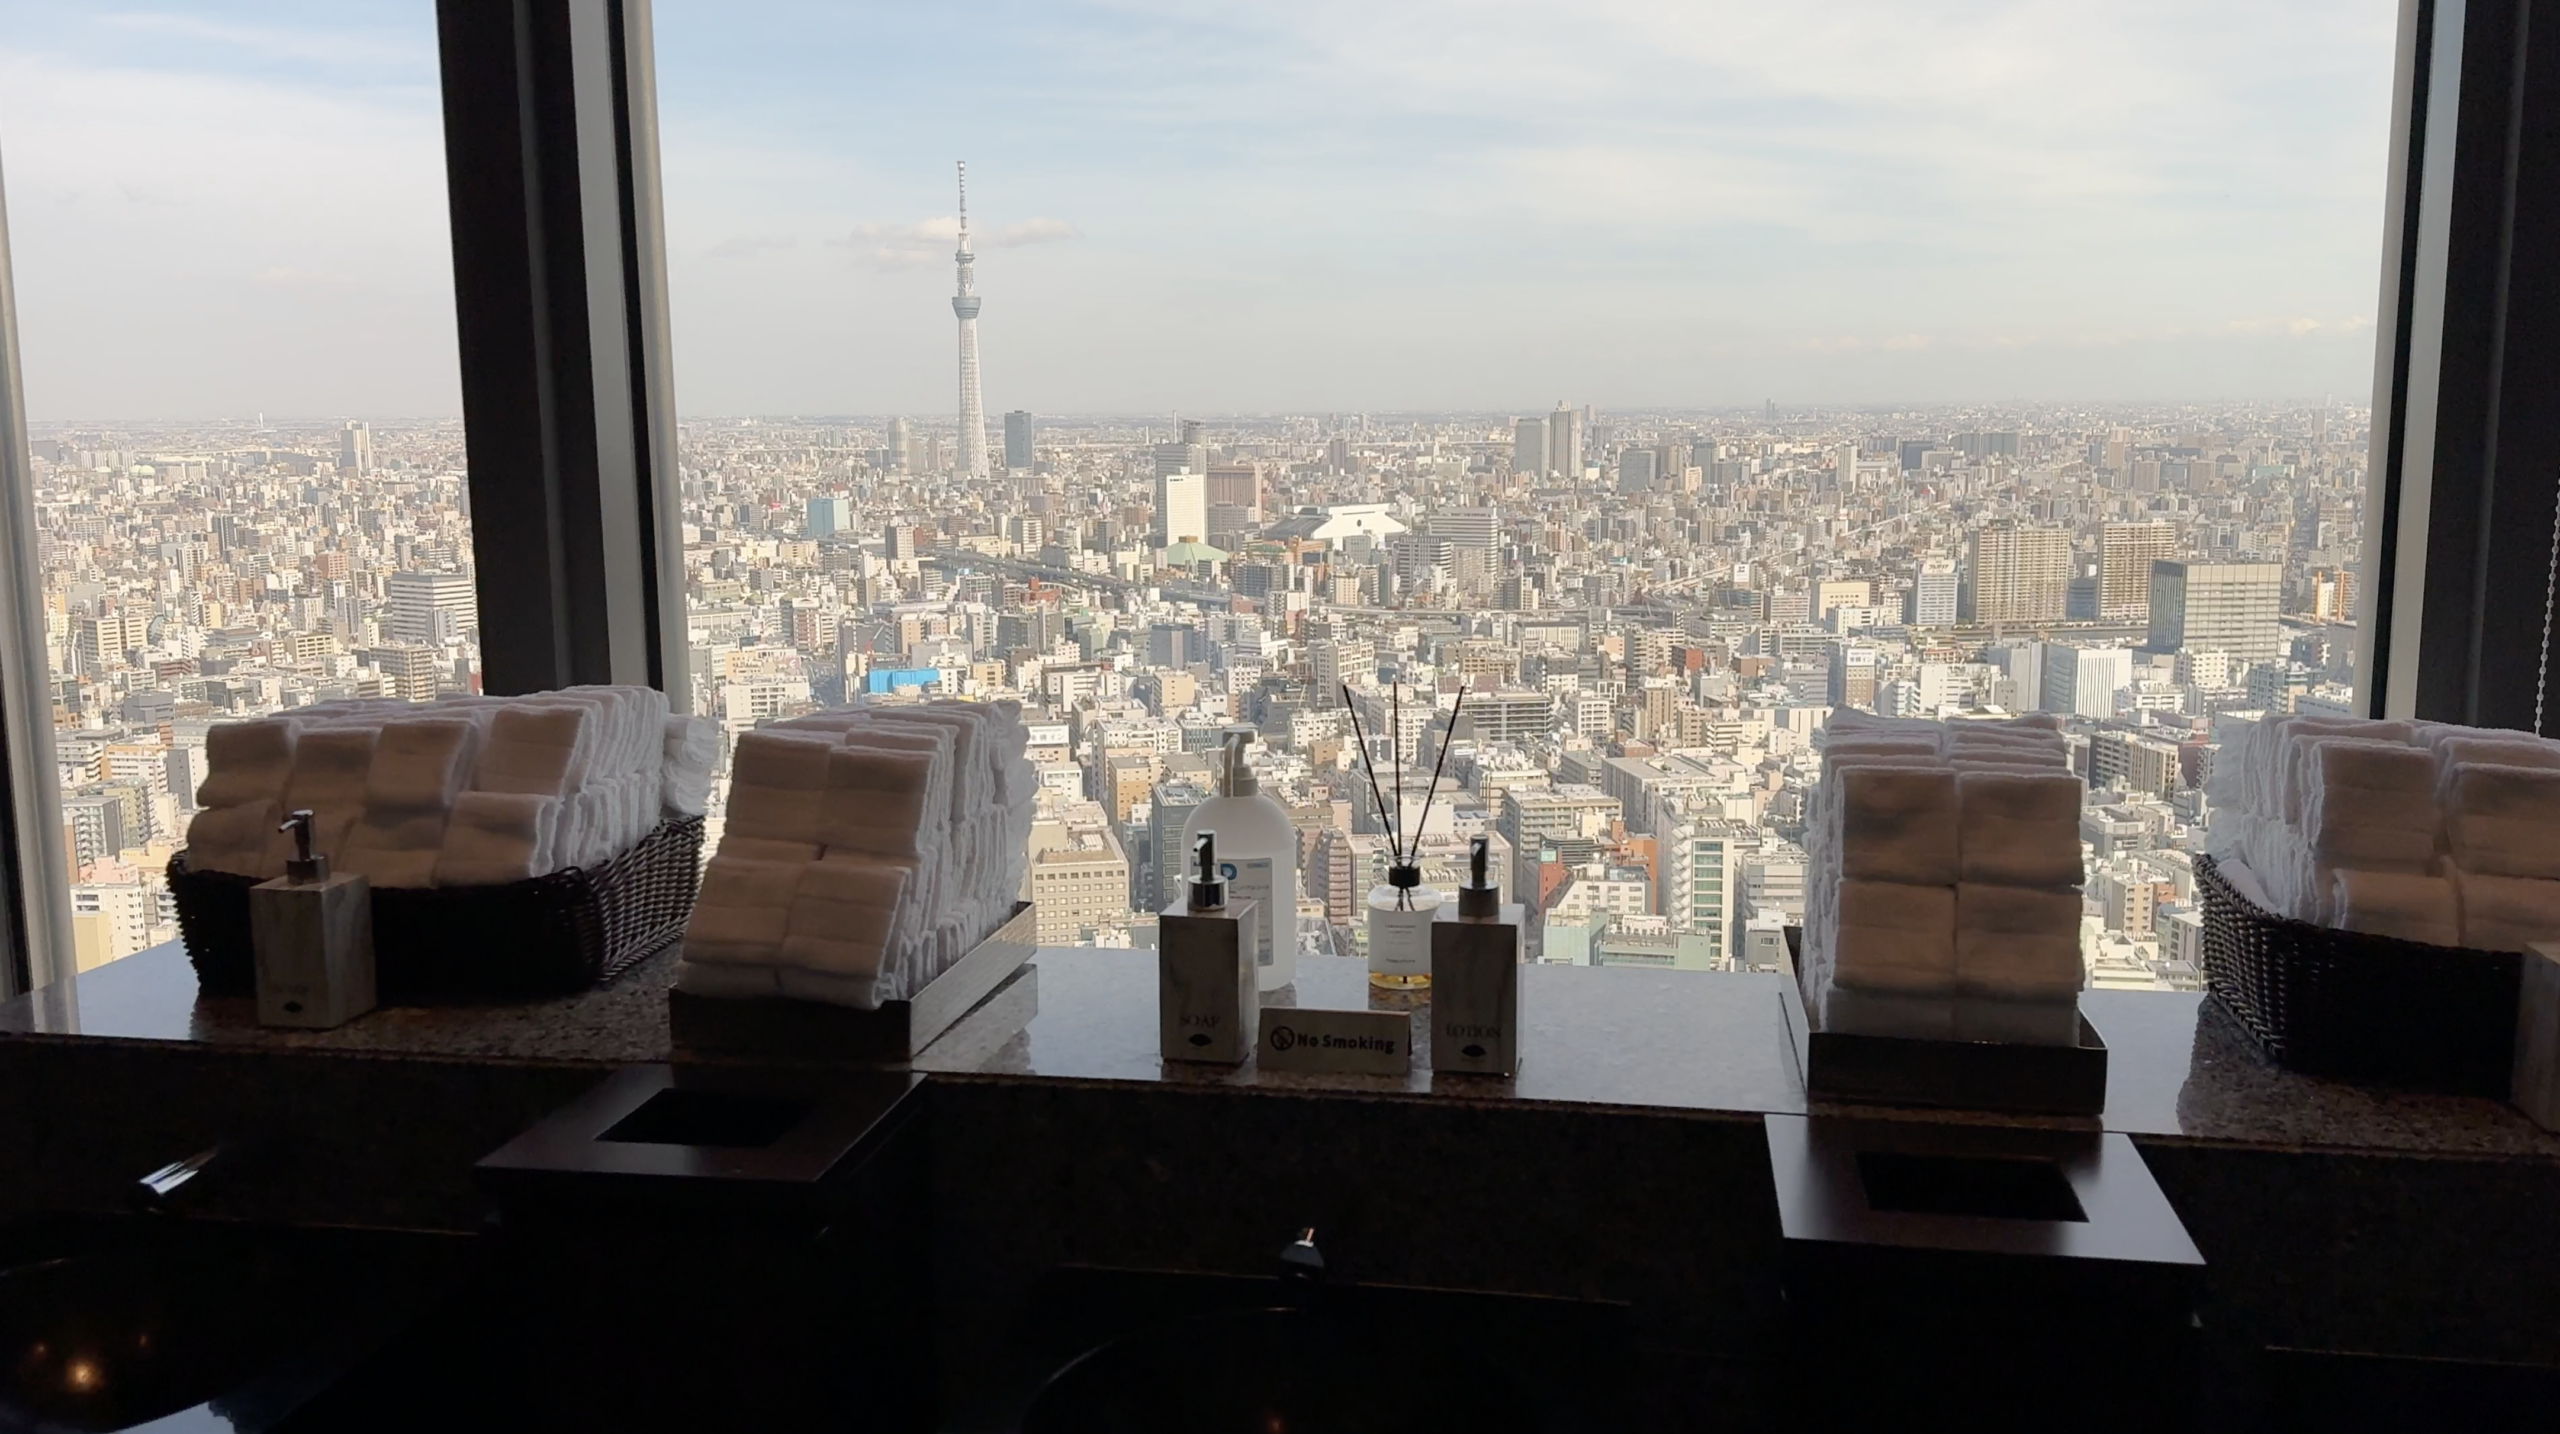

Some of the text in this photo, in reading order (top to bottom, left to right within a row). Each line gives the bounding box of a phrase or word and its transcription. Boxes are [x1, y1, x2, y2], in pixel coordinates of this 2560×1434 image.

[1180, 1014, 1221, 1028] SOAP
[1446, 1024, 1501, 1038] LOTION
[1297, 1033, 1395, 1055] No Smoking
